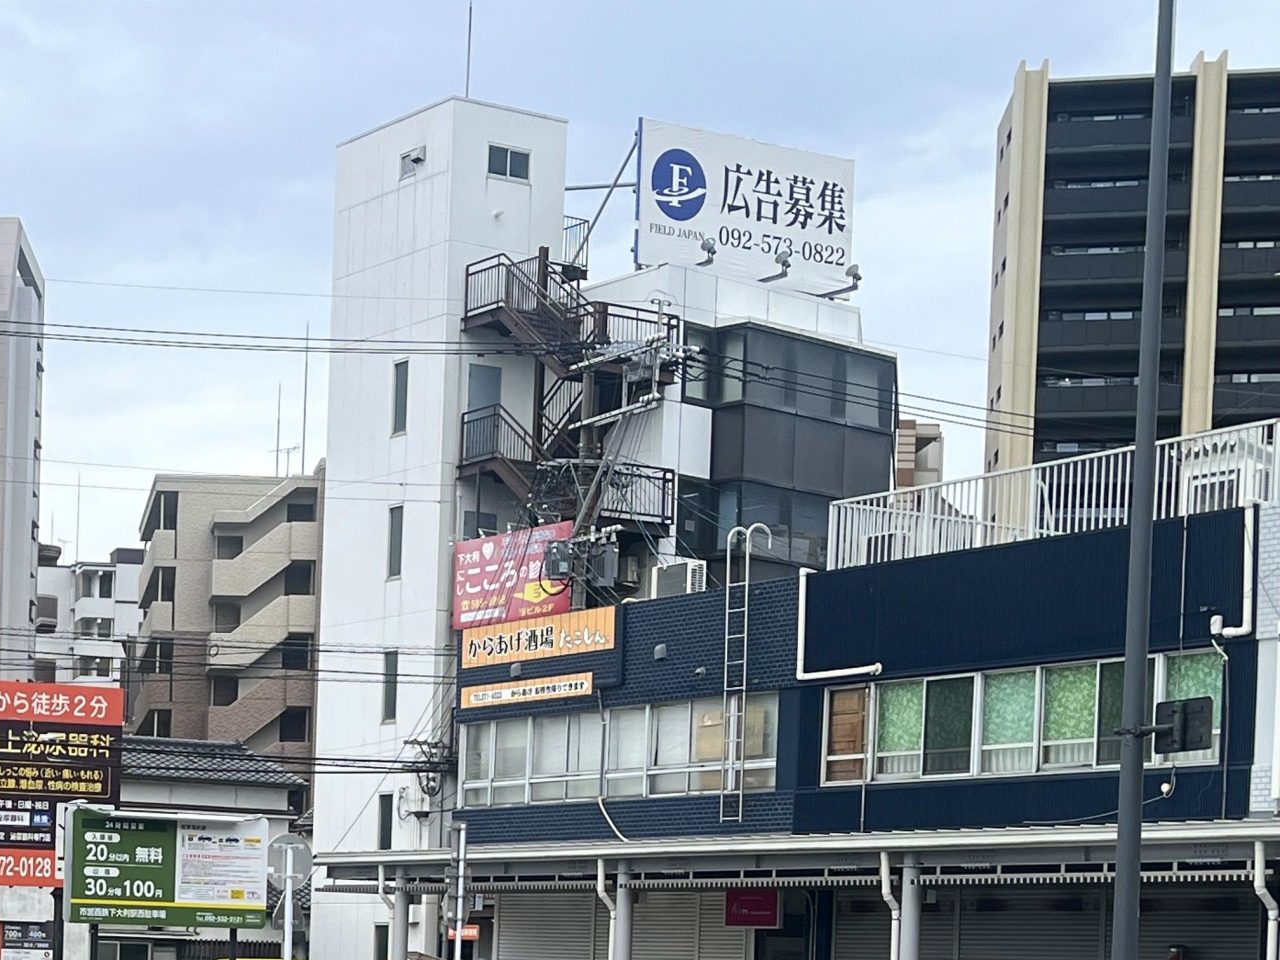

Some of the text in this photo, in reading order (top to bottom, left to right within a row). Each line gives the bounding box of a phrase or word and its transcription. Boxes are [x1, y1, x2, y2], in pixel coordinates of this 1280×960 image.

[720, 162, 846, 235] 広告募集
[649, 222, 706, 242] FIELD JAPAN
[718, 225, 846, 267] 092-573-0822
[468, 626, 554, 658] からあげ酒場
[135, 847, 163, 864] 無料
